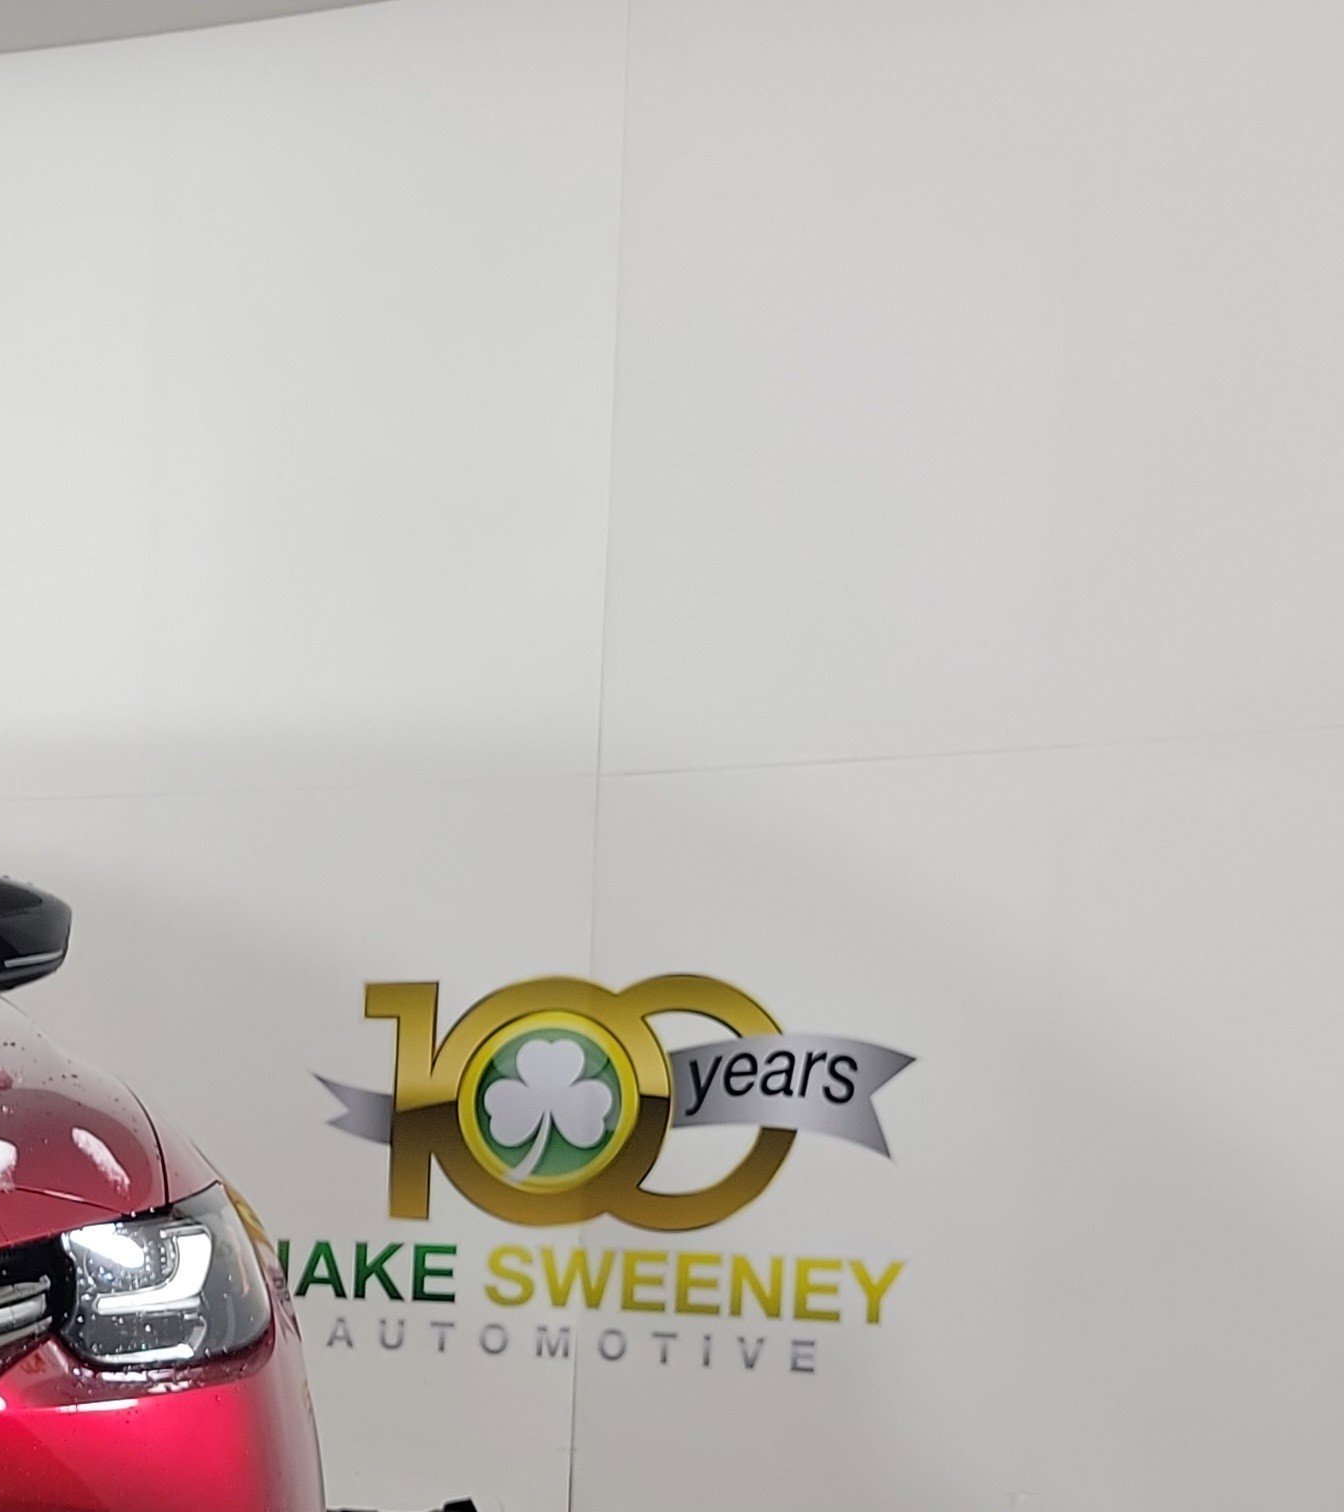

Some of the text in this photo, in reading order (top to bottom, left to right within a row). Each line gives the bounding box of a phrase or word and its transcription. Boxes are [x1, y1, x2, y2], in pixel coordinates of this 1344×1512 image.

[364, 974, 858, 1232] 100 years
[484, 1244, 906, 1326] SWEENEY
[326, 1317, 818, 1374] AUTOMOTIVE
